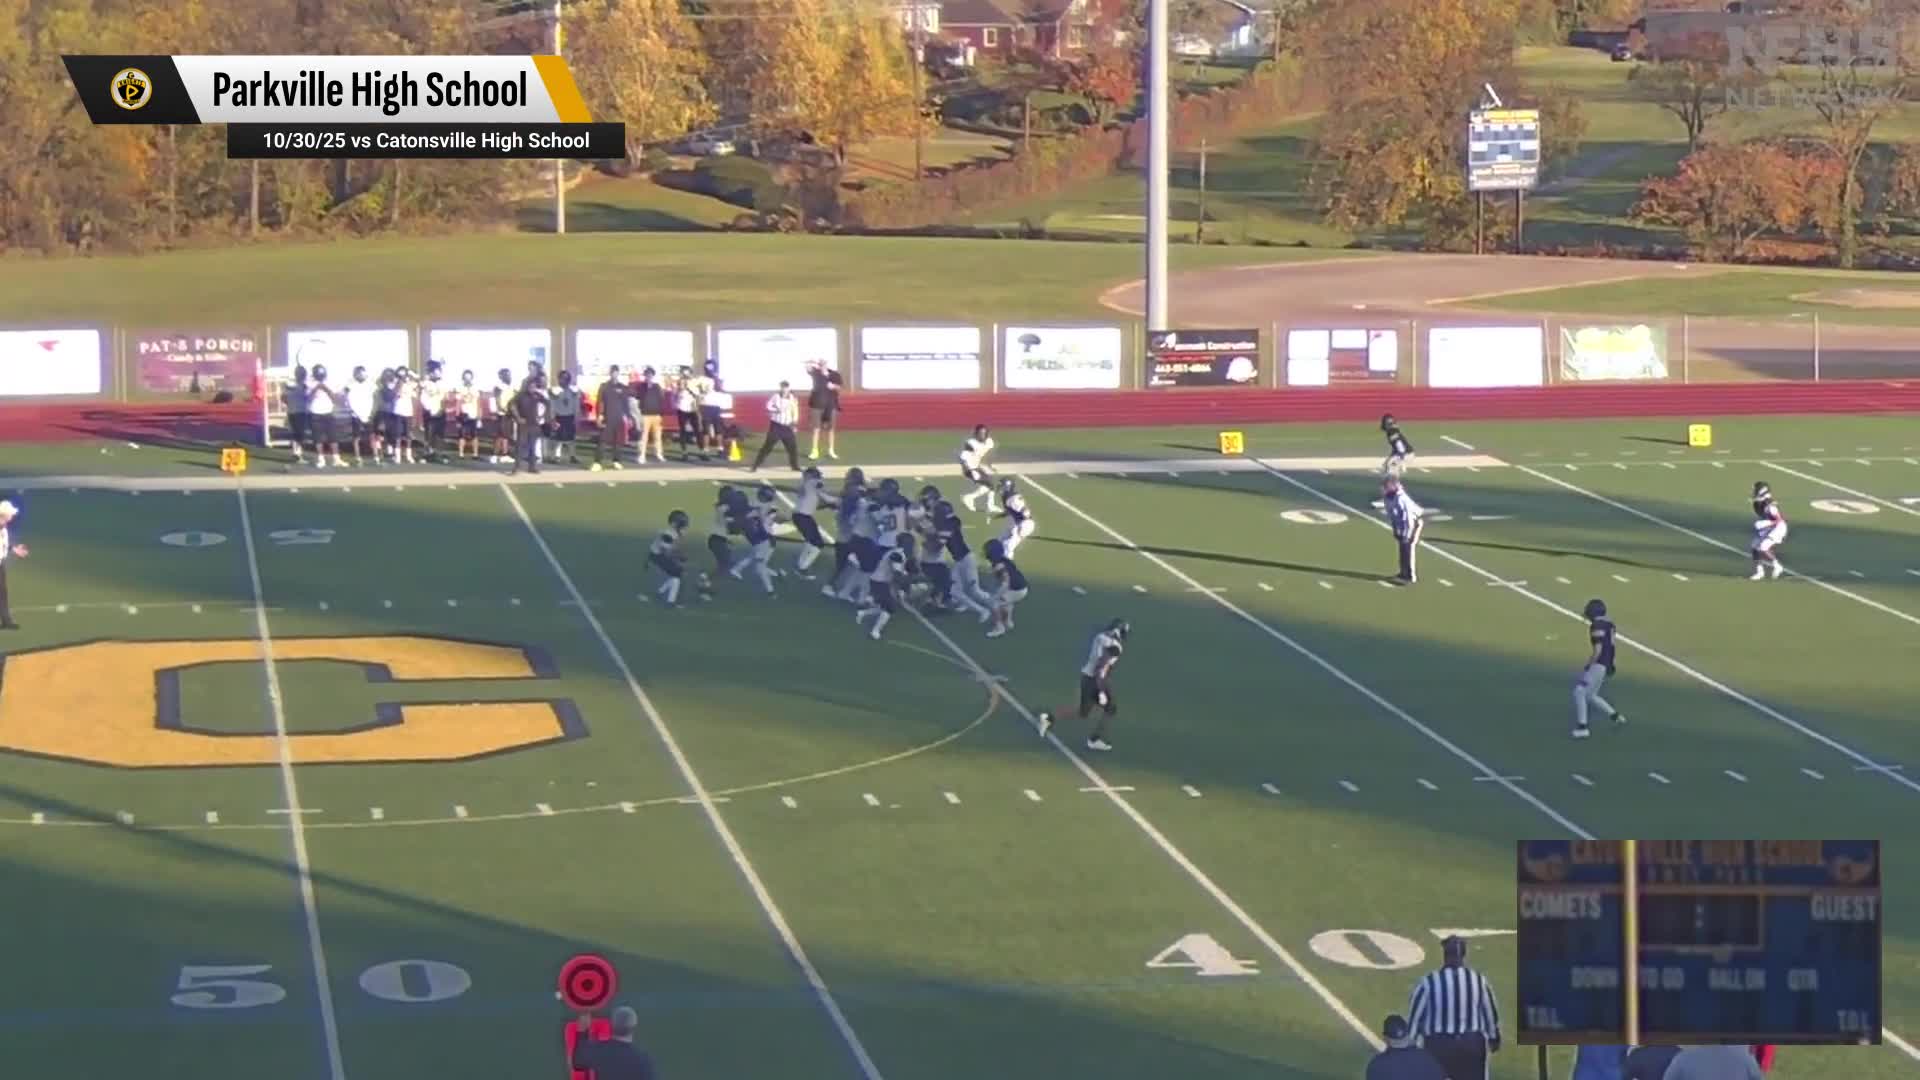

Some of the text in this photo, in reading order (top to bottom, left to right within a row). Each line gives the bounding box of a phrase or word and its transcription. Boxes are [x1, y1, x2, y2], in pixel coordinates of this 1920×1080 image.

[195, 339, 253, 352] PORCH
[1520, 891, 1601, 920] COMETS
[1810, 895, 1876, 921] GUEST
